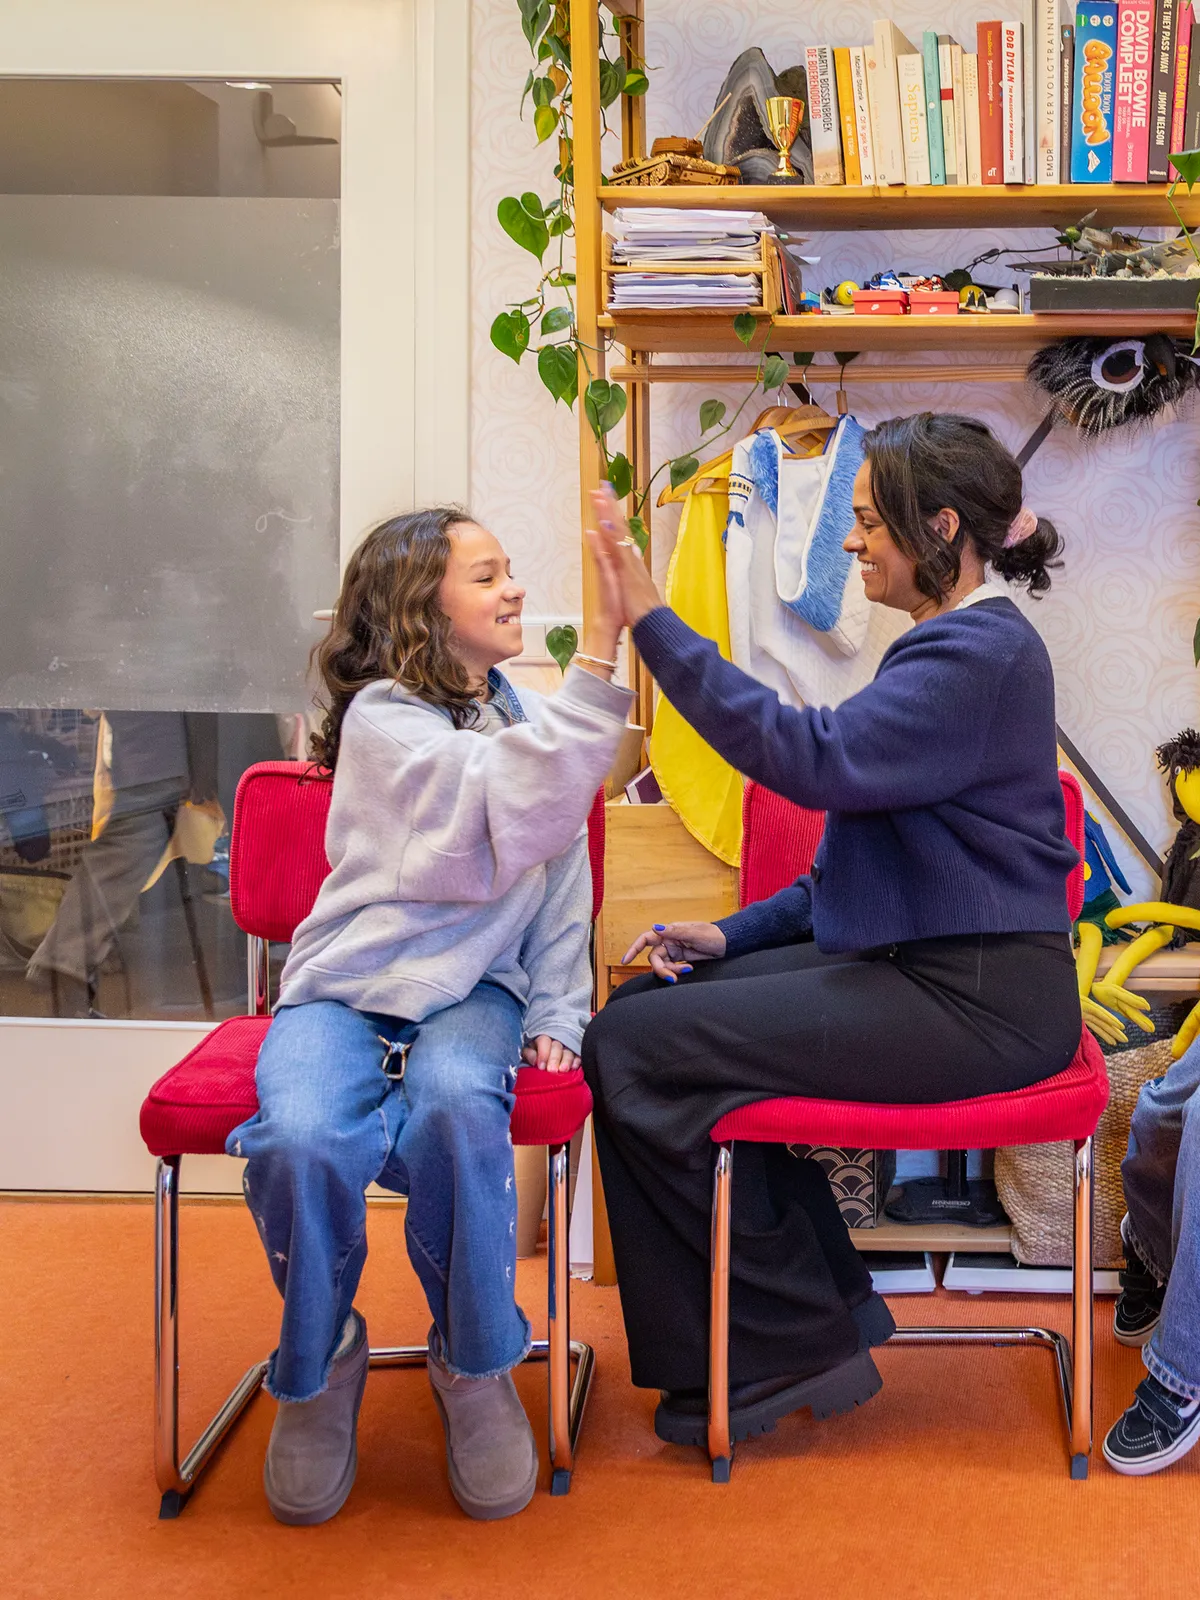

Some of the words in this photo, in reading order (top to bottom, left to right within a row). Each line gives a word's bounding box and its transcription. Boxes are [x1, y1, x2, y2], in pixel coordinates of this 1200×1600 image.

[1162, 10, 1172, 30] THEY
[1006, 29, 1015, 48] BOB
[1134, 10, 1150, 65] DAVID
[1161, 30, 1171, 51] PASS
[806, 48, 817, 59] DE
[817, 47, 829, 77] MARTIN
[854, 55, 863, 78] Michiel
[1006, 51, 1015, 83] DYLAN
[1118, 9, 1135, 105] COMPLEET
[1159, 51, 1169, 75] AWAY
[807, 60, 821, 119] BOERENOORLOG
[855, 79, 865, 100] Stroink
[1103, 71, 1113, 92] BOOM
[1175, 44, 1188, 109] STARMAN
[819, 78, 833, 133] BOSSENBROEK
[1082, 40, 1112, 145] BALLOON
[1102, 94, 1112, 114] BOOM
[1132, 69, 1148, 128] BOWIE
[1157, 89, 1167, 115] JIMMY
[904, 83, 922, 143] Sapiens
[1155, 116, 1166, 146] NELSON
[1046, 148, 1054, 177] EMDR
